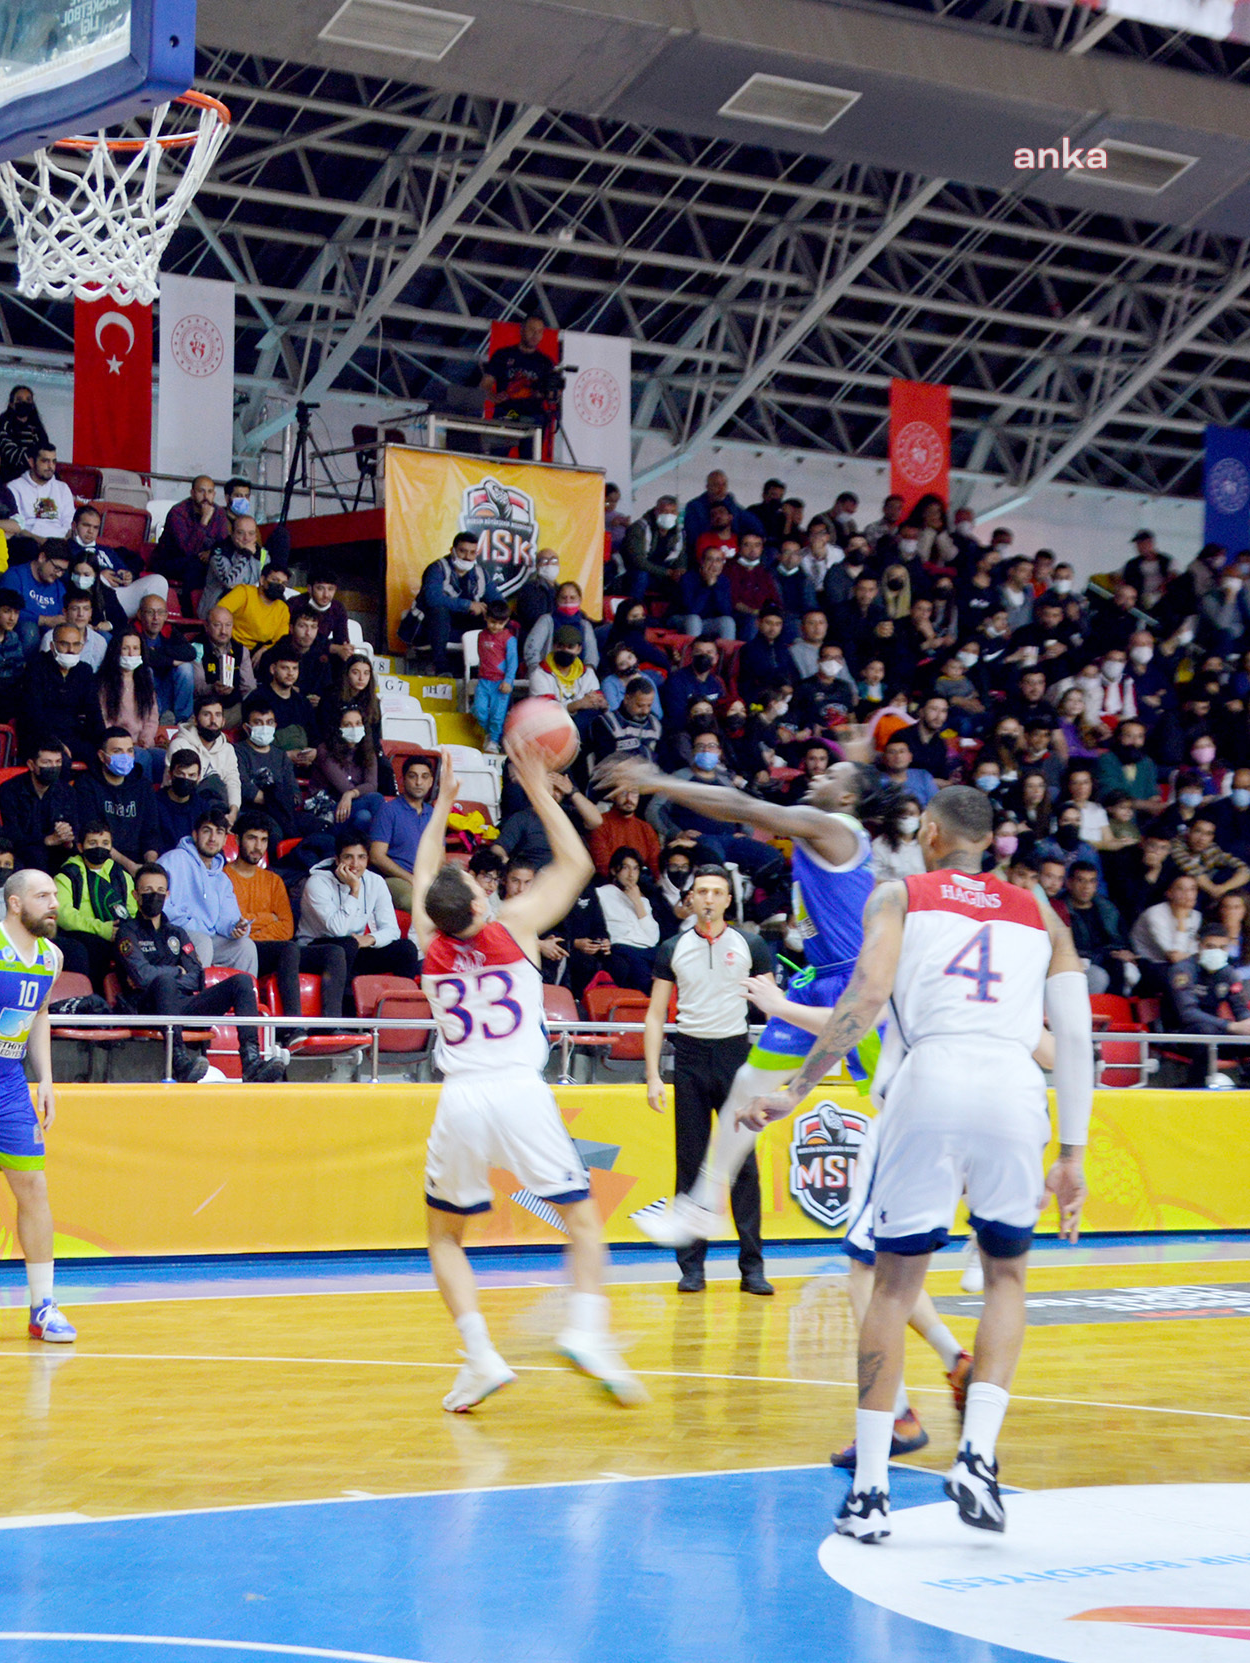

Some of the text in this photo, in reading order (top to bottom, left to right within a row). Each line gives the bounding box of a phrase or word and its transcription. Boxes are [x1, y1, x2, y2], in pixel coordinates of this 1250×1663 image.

[397, 681, 404, 692] 7
[939, 884, 1003, 909] HAGINS
[943, 922, 1004, 1004] 4
[17, 979, 40, 1009] 10
[435, 969, 523, 1047] 33
